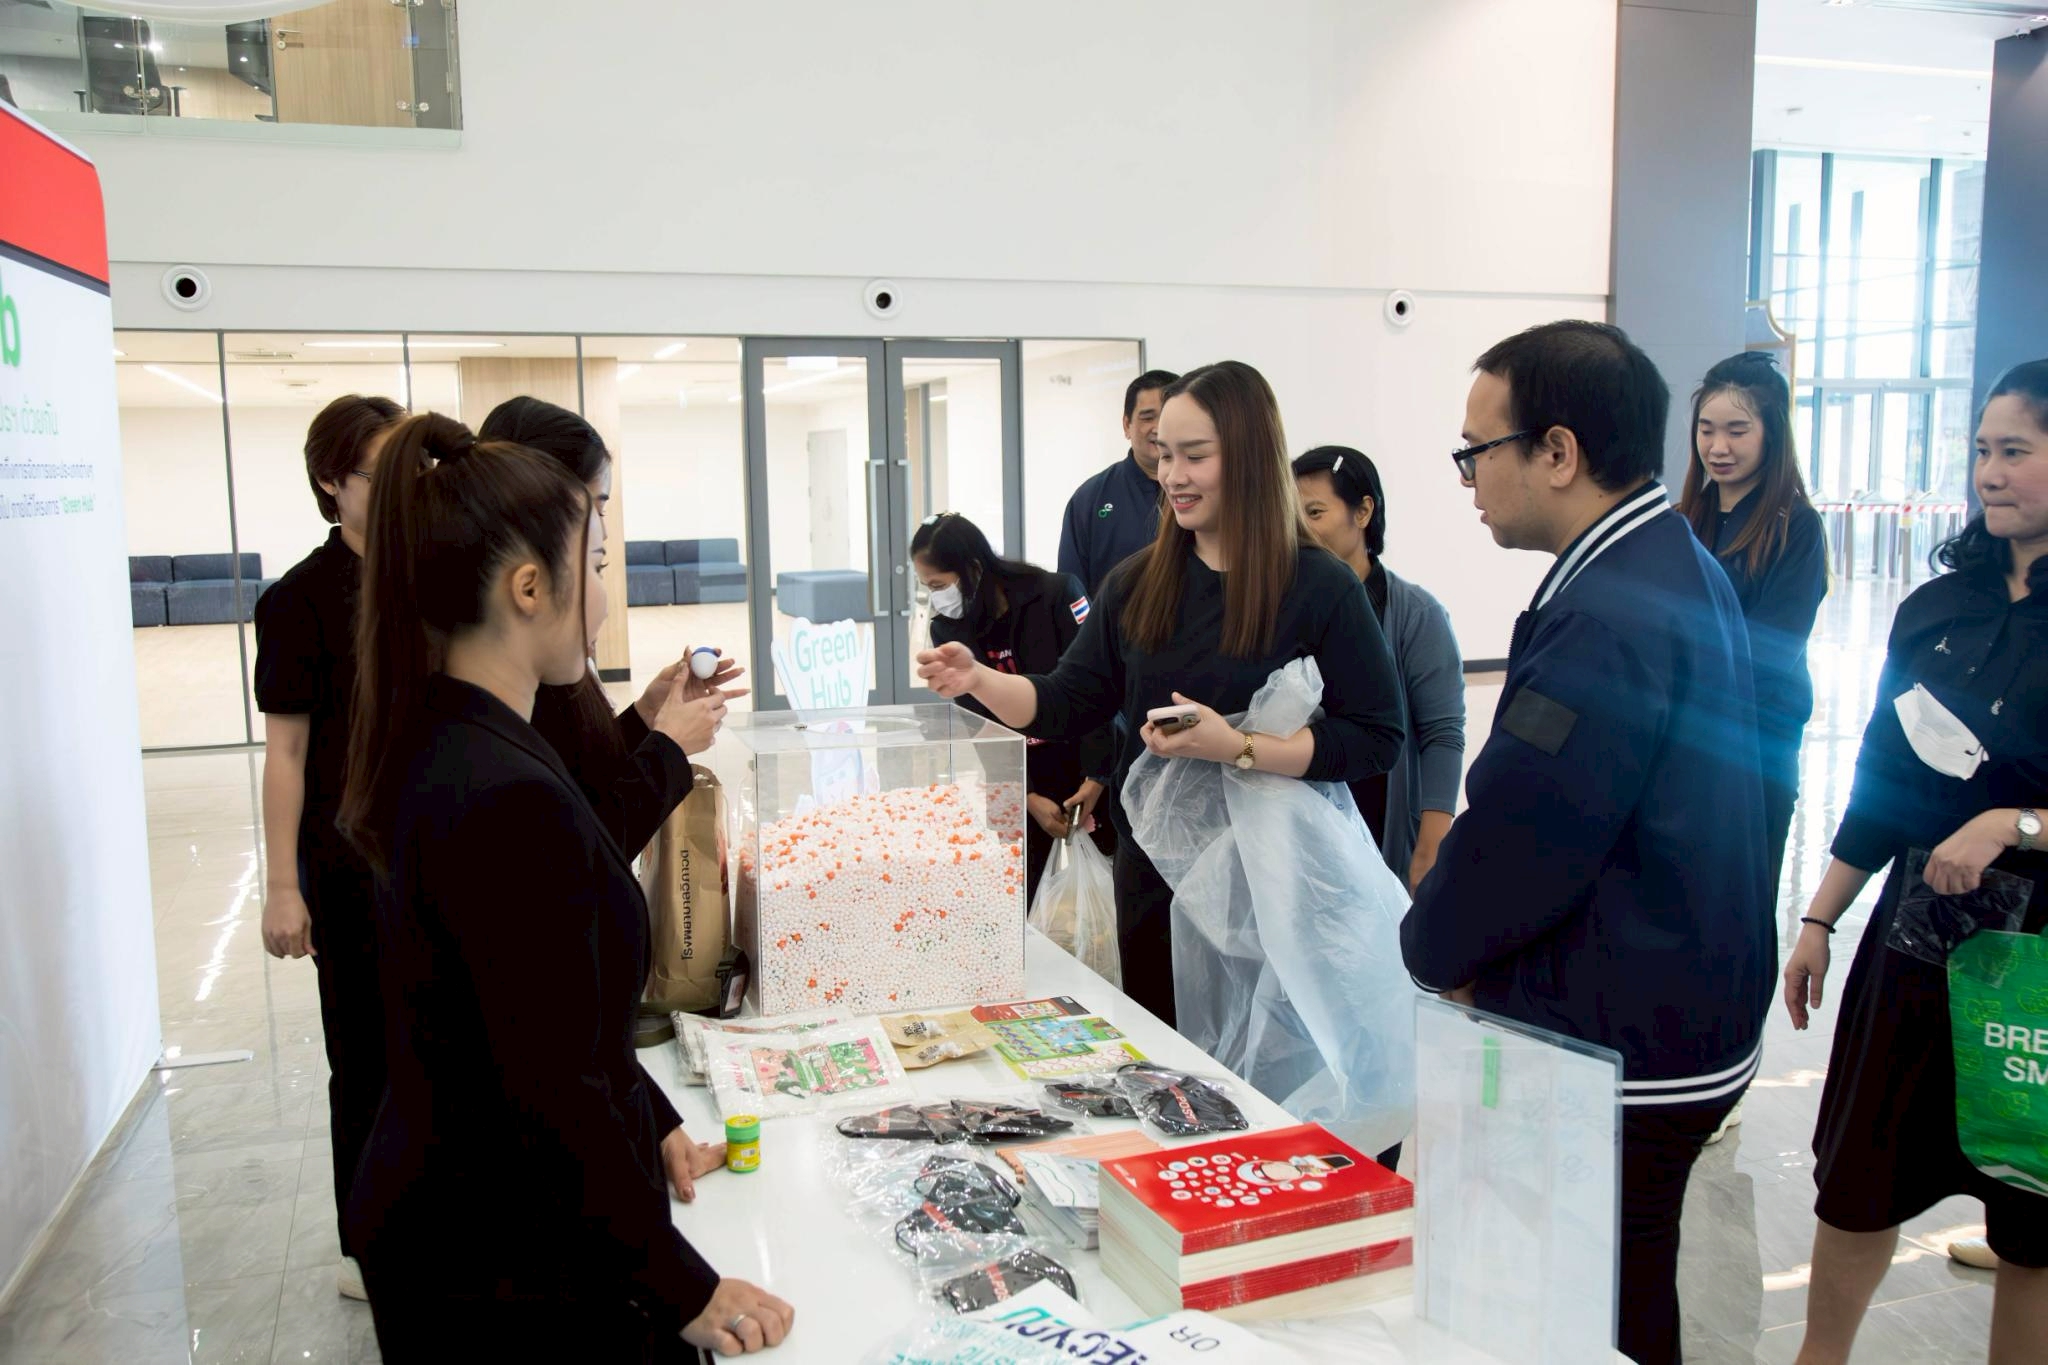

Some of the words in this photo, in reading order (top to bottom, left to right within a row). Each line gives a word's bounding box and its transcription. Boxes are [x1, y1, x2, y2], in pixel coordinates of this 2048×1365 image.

[795, 630, 857, 672] Green
[811, 670, 852, 708] Hub
[1169, 1325, 1221, 1352] OR
